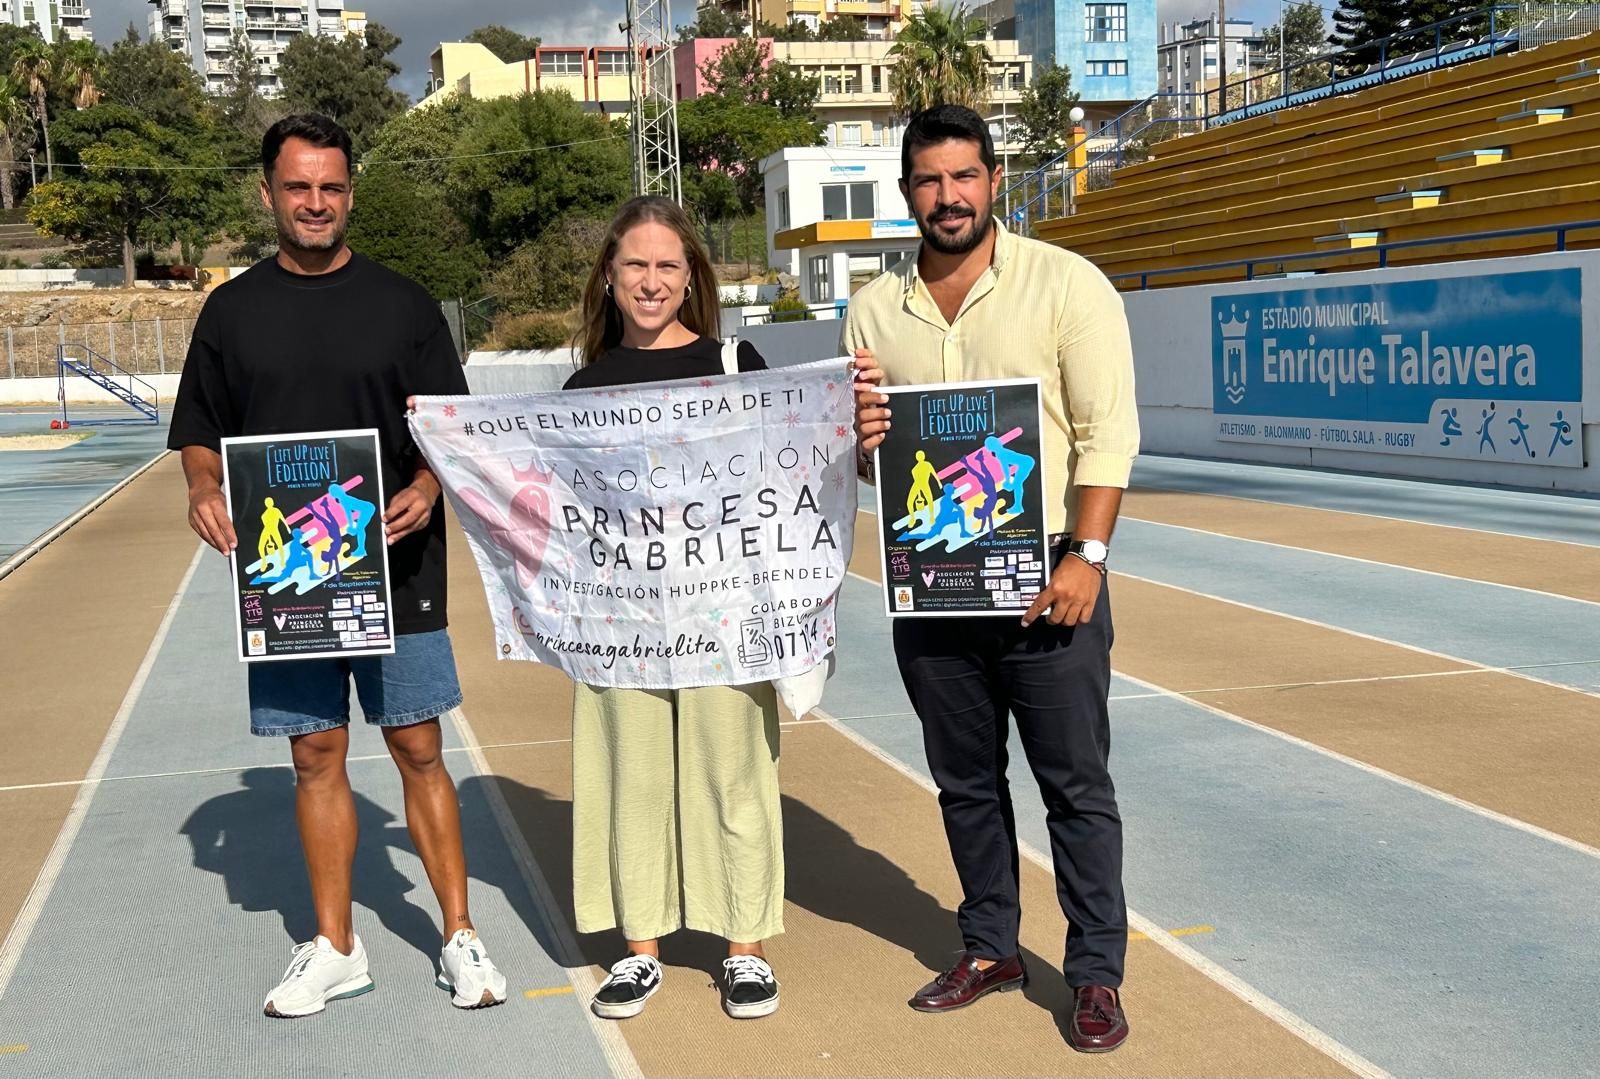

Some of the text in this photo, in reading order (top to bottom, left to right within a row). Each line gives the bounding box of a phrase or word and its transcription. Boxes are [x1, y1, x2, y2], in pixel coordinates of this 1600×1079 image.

[1262, 301, 1389, 330] ESTADIO MUNICIPAL
[1263, 330, 1537, 397] Enrique Talavera
[463, 388, 803, 436] #QUE EL MUNDO SEPA DE TI
[927, 394, 988, 414] LIFT UP LIVE
[929, 412, 987, 435] EDITION
[1219, 422, 1256, 437] ATLETISMO
[1264, 427, 1311, 440] BALONMANO
[1320, 426, 1351, 443] FÚTBOL
[1352, 429, 1375, 445] SALA
[1385, 432, 1416, 448] RUGBY
[274, 444, 330, 463] LIFT UP LIVE
[573, 440, 830, 492] ASOCIACIÓN
[276, 461, 330, 482] EDITION
[562, 484, 819, 538] PRINCESA
[590, 519, 837, 571] GABRIELA
[670, 566, 834, 598] HUPPKE-BRENDEL
